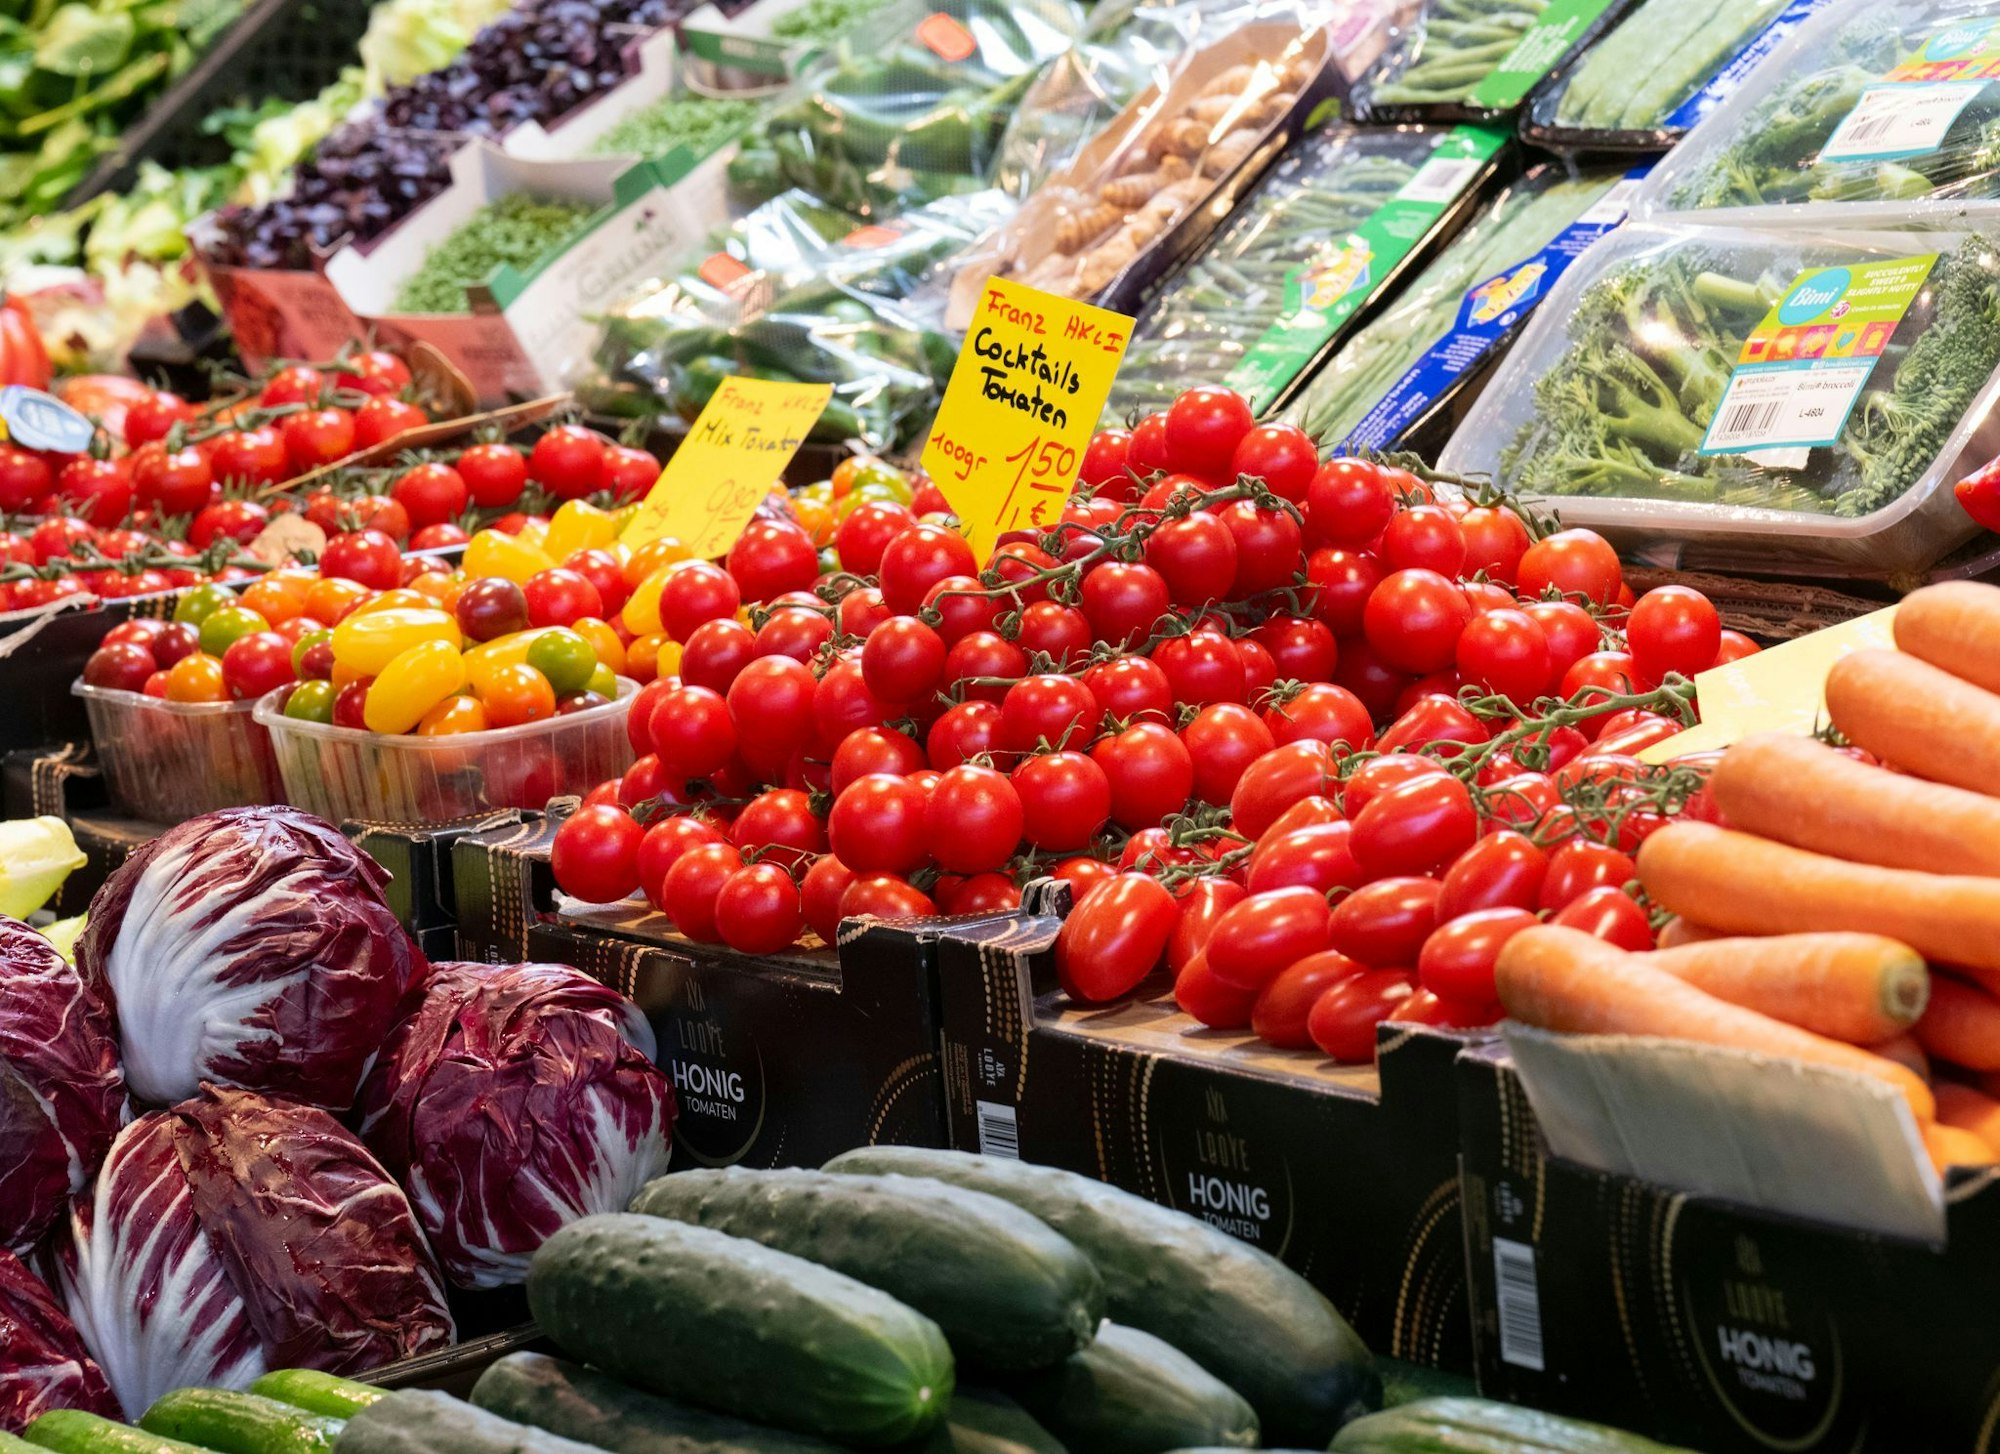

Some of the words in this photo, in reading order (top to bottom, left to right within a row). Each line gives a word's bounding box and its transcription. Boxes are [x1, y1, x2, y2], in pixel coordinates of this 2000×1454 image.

[1789, 287, 1840, 308] Bimi
[1888, 282, 1919, 293] NUTTY
[988, 290, 1047, 335] Franz
[974, 327, 1080, 394] Cocktails
[981, 366, 1067, 430] Tomaten
[1822, 379, 1855, 390] broccoli
[695, 416, 734, 447] Mix
[932, 432, 988, 481] 100gr
[678, 1017, 726, 1057] LOOYE
[672, 1059, 745, 1103] HONIG
[685, 1095, 737, 1121] TOMATEN
[1188, 1172, 1270, 1220] HONIG
[1717, 1324, 1816, 1381] HONIG
